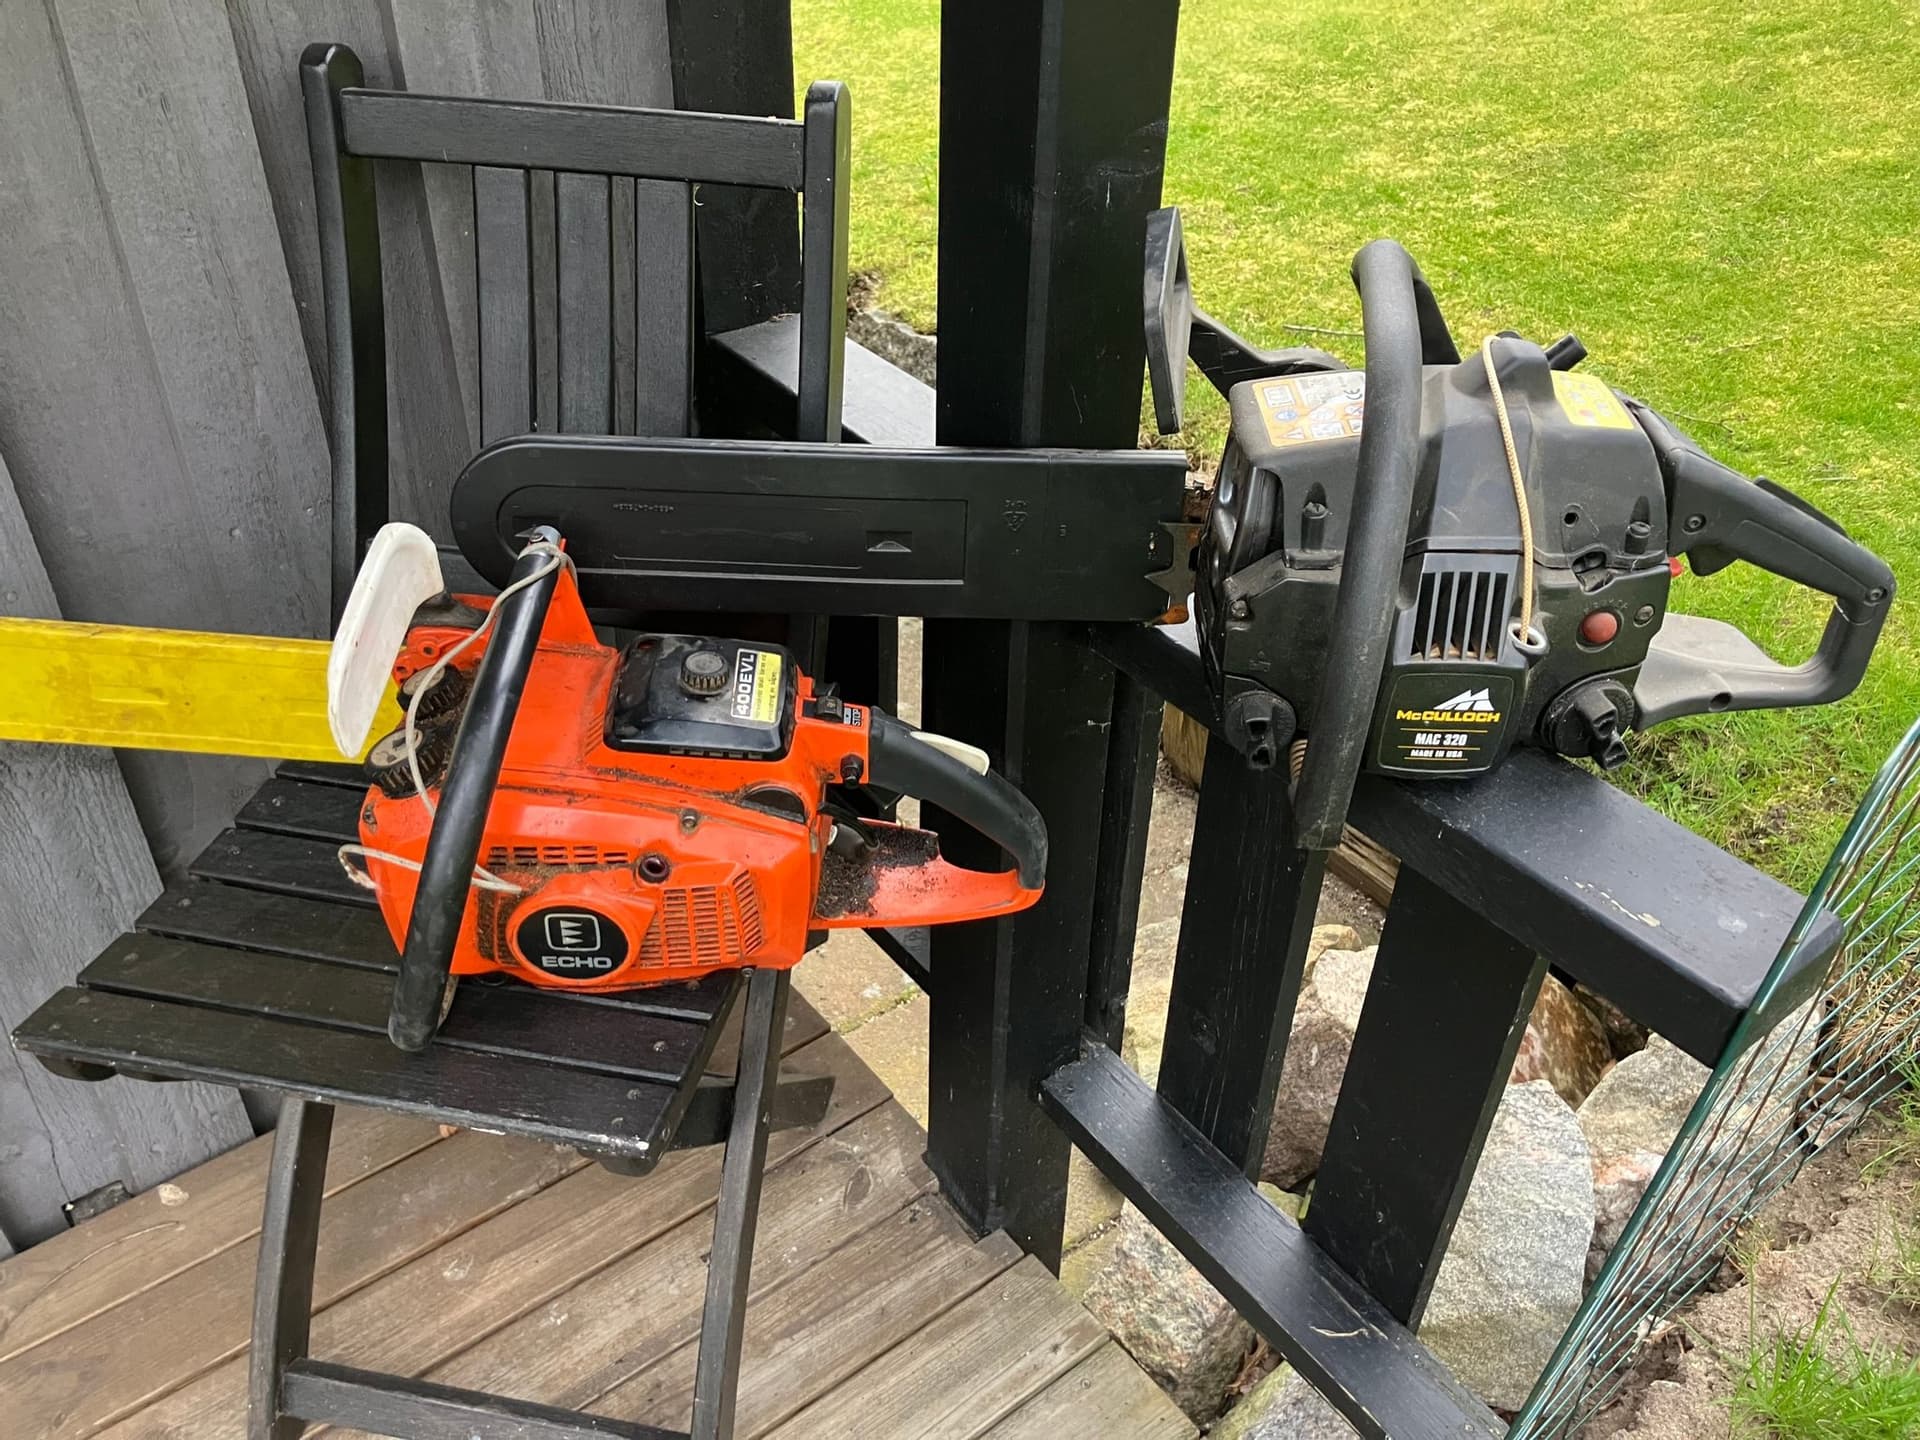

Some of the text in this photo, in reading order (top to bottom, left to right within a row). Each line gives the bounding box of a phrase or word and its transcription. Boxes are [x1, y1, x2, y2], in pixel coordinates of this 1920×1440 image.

[736, 654, 755, 715] 400EVL
[1396, 710, 1501, 722] McCULLOCH
[1414, 733, 1468, 746] MAC 320
[1410, 749, 1463, 758] MADE IN USA
[541, 955, 612, 969] ECHO
